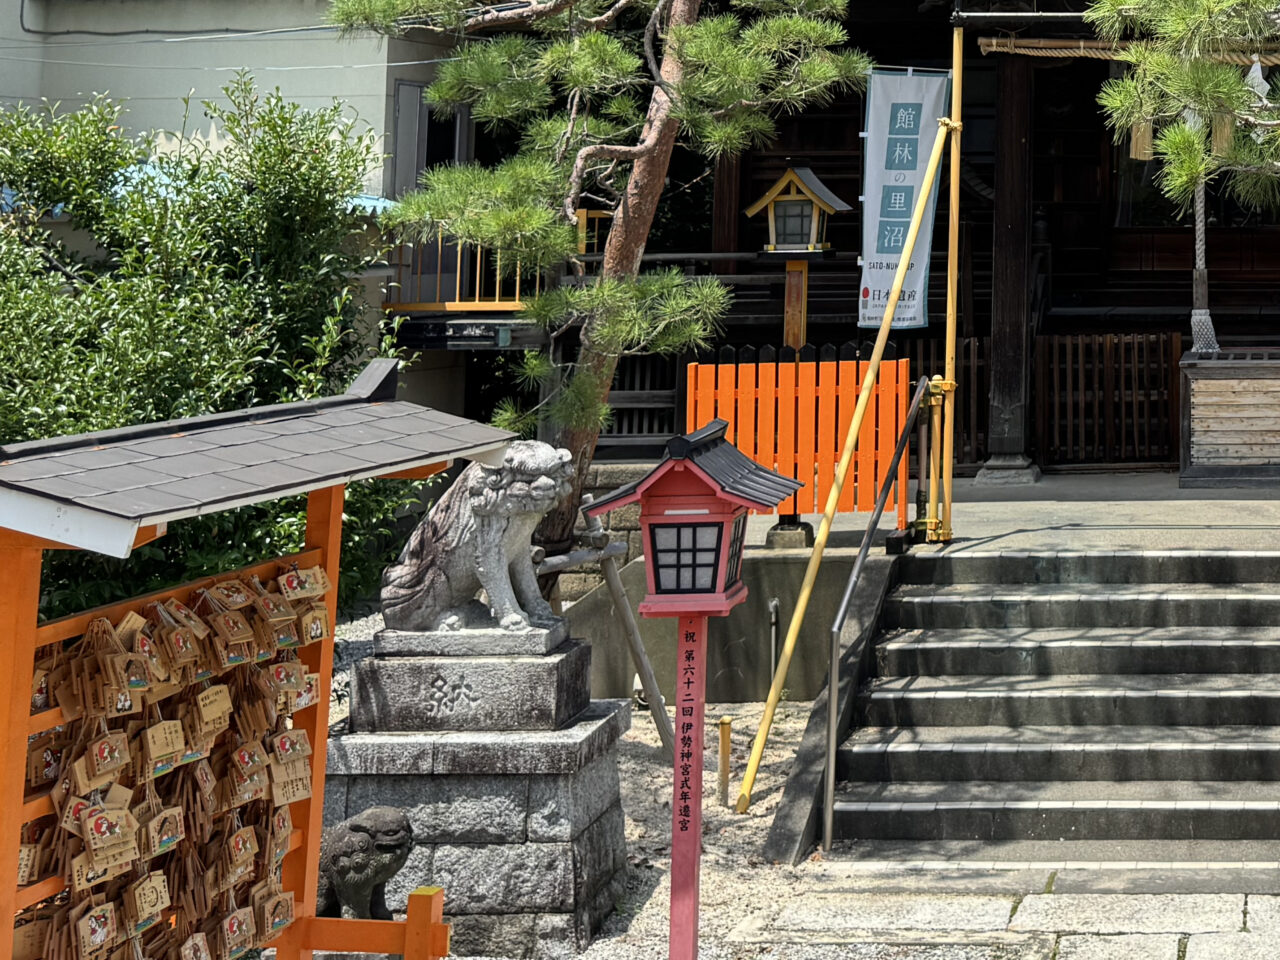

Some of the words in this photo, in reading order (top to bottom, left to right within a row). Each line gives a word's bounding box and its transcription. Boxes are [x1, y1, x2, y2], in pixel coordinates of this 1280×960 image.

[884, 108, 916, 248] 館林の里沼
